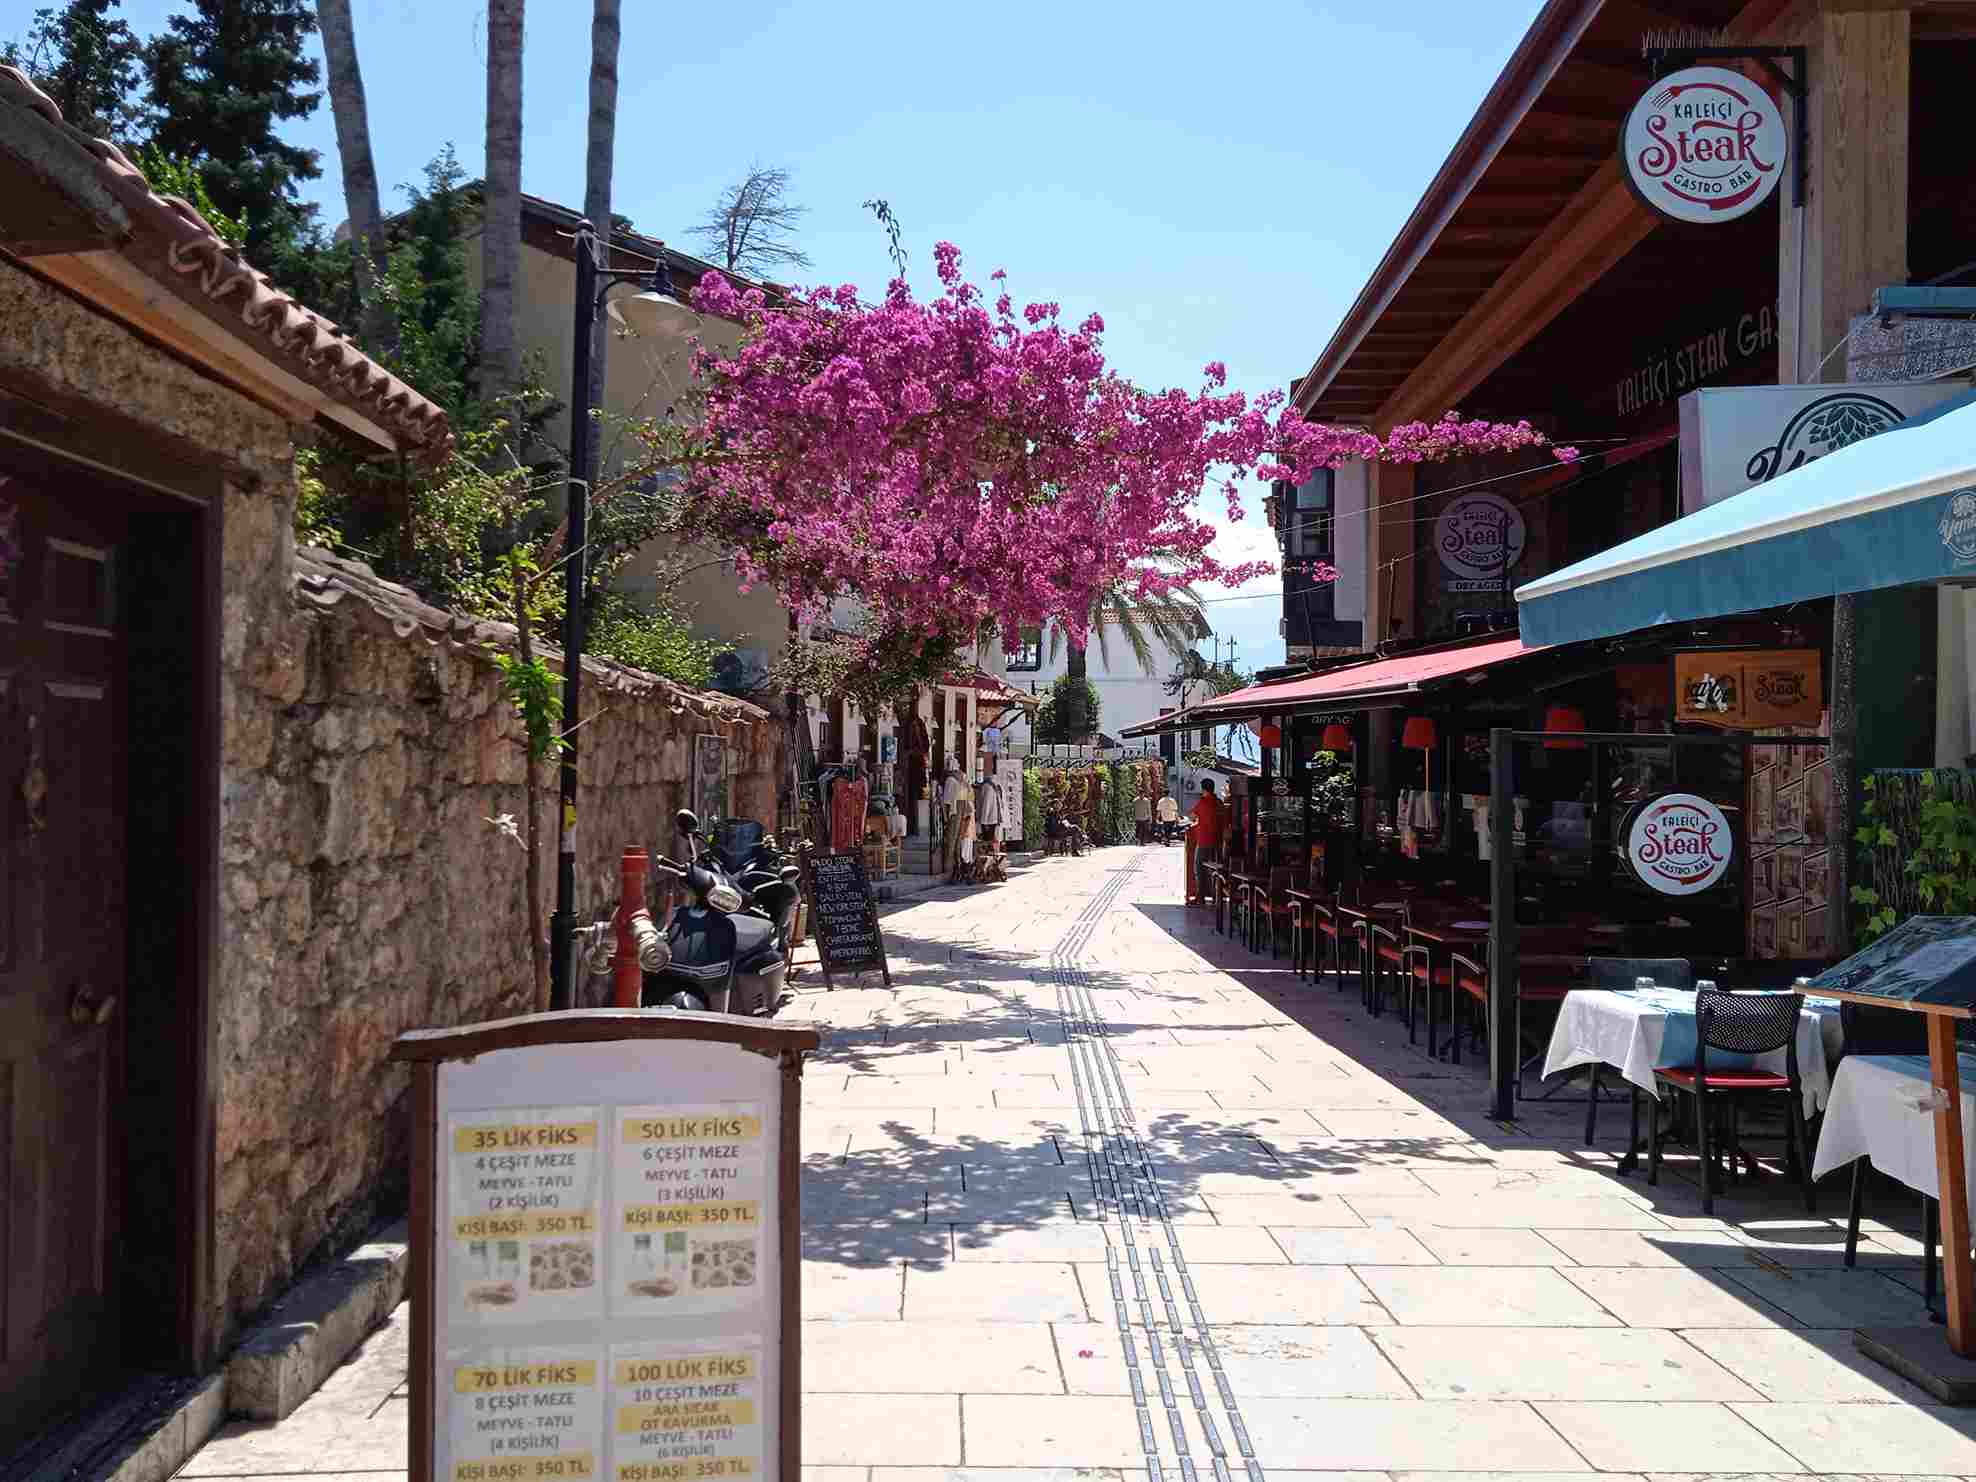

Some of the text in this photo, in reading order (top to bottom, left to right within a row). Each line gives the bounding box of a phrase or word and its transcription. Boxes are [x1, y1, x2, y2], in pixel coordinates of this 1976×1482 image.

[1674, 98, 1733, 120] KALEİÇİ
[1638, 111, 1776, 177] Steak
[1673, 170, 1753, 193] GASTRO BAR
[1616, 347, 1671, 417] KALEİÇİ
[1675, 327, 1729, 387] STEAK
[1736, 303, 1779, 357] GA
[1441, 511, 1519, 553] Steak
[1639, 822, 1724, 863] Steak
[473, 1131, 497, 1147] 35
[537, 1125, 577, 1145] FİKS
[642, 1117, 742, 1138] 50 LİK FİKS
[475, 1152, 576, 1171] 4 ÇEŞİT MEZE
[643, 1144, 739, 1163] 6 ÇEŞİT MEZE
[480, 1177, 525, 1191] MEYVE
[536, 1175, 573, 1188] TATLI
[645, 1169, 690, 1182] MEYVE
[703, 1167, 737, 1180] TATLI
[675, 1184, 724, 1203] KİŞİLİK)
[536, 1217, 566, 1232] 350
[626, 1209, 653, 1226] KİŞİ
[700, 1207, 729, 1223] 350
[473, 1371, 497, 1387] 70
[537, 1363, 577, 1384] FİKS
[628, 1365, 661, 1383] 100
[708, 1355, 748, 1376] FİKS
[475, 1391, 576, 1411] 8 ÇEŞİT MEZE
[634, 1383, 739, 1403] 10 ÇEŞİT MEZE
[478, 1417, 525, 1432] MEYVE
[536, 1416, 573, 1430] TATLI
[641, 1418, 660, 1431] OT
[640, 1431, 687, 1446] MEYVE
[697, 1429, 734, 1442] TATLI
[536, 1460, 564, 1475] 350
[696, 1461, 727, 1477] 350
